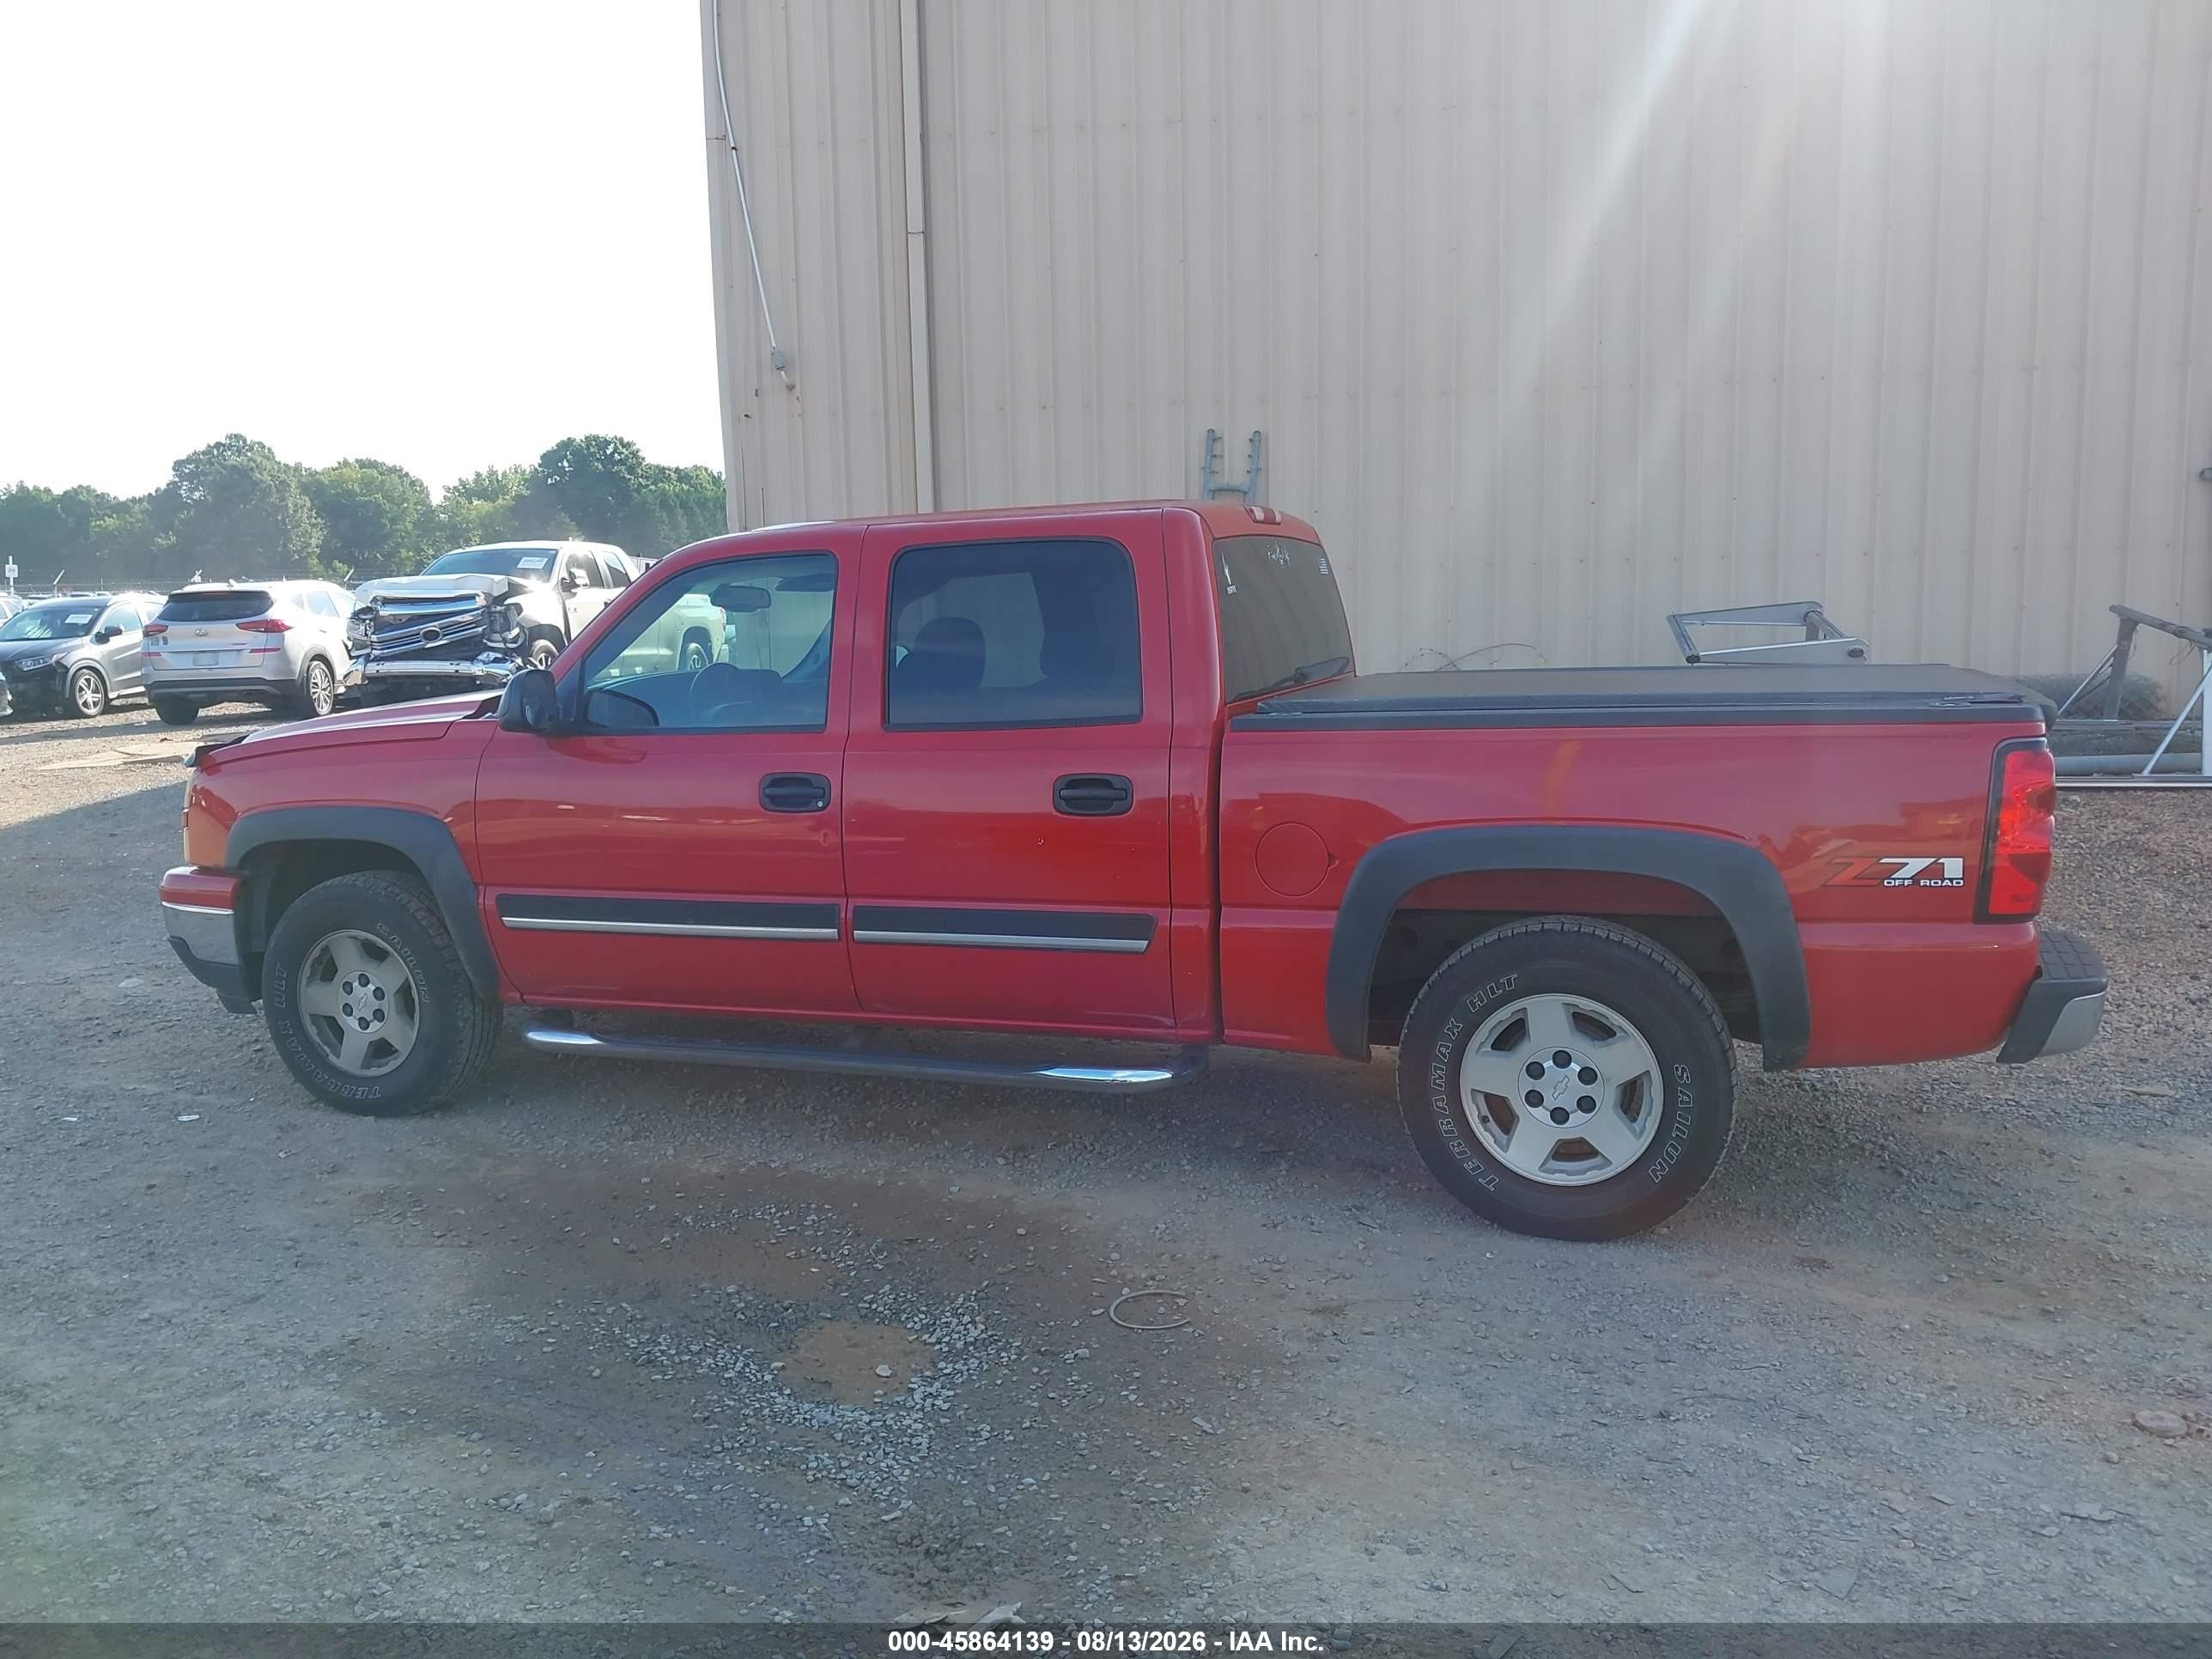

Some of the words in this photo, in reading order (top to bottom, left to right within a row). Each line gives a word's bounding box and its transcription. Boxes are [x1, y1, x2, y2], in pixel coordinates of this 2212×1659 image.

[1824, 856, 1965, 886] Z71
[1883, 878, 1912, 887] OFF
[1920, 878, 1965, 887] ROAD
[1430, 1017, 1499, 1192] TERRAMAX
[1467, 973, 1517, 1013] HLT
[1648, 1064, 1693, 1184] SAILUN
